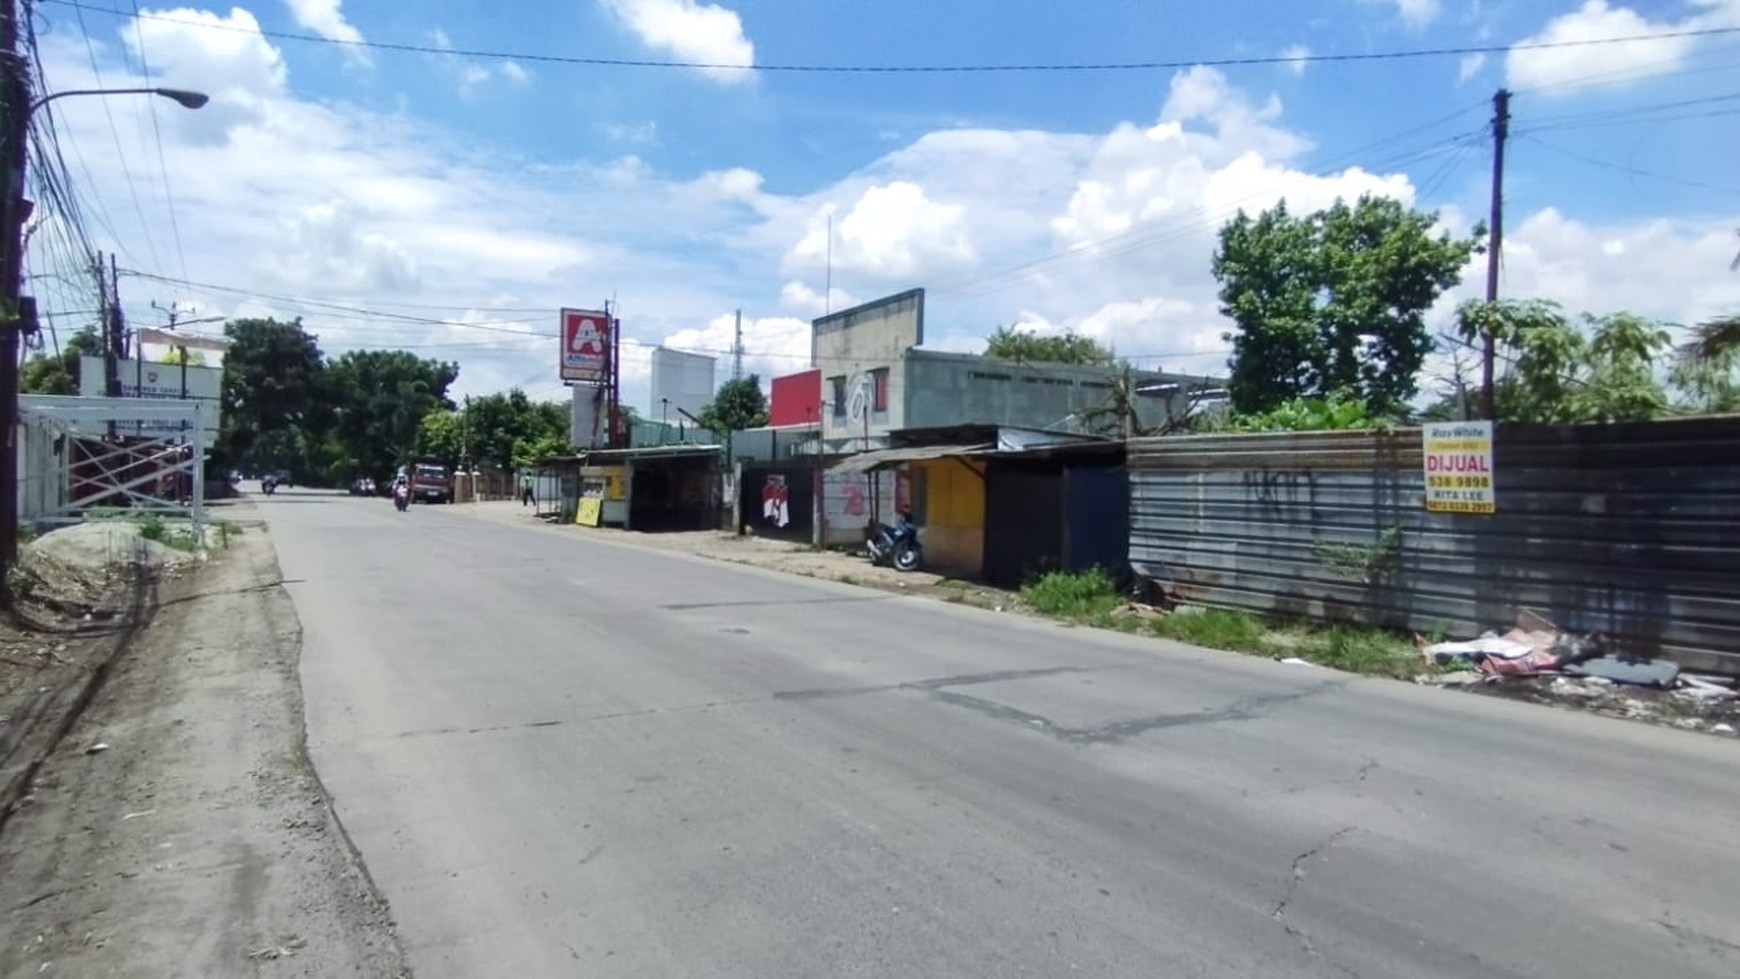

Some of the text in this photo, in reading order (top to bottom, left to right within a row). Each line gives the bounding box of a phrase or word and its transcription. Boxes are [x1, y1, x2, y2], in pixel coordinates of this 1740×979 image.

[1427, 455, 1489, 472] DIJUAL
[1457, 476, 1489, 488] 9898
[1434, 490, 1483, 500] RITA LEE
